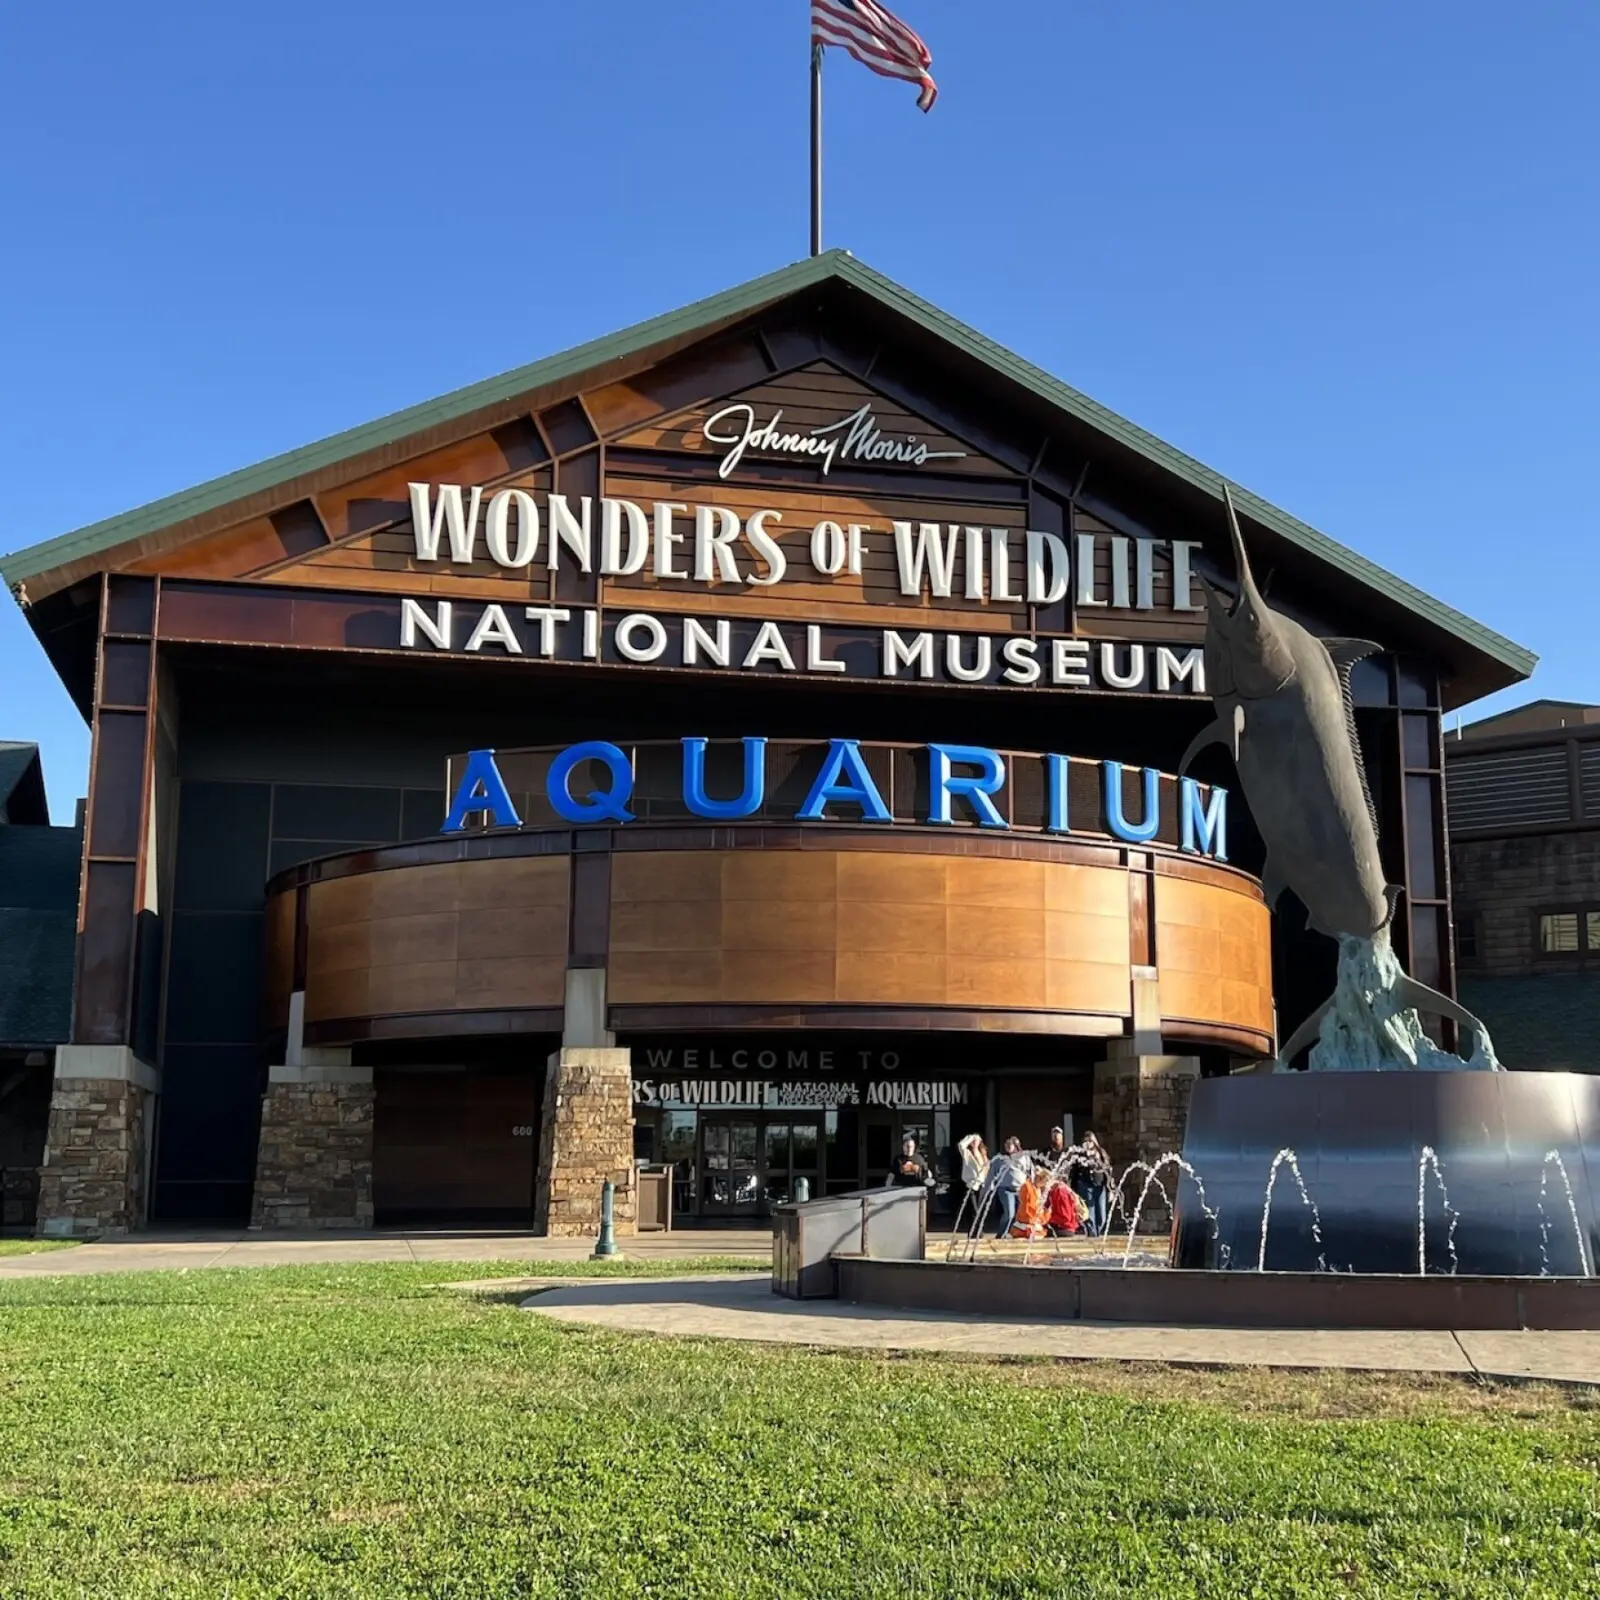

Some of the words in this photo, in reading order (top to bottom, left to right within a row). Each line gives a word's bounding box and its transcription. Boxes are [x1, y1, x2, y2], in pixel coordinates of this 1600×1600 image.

[703, 404, 840, 479] Johnny
[810, 402, 967, 465] Morris
[407, 482, 788, 587] WONDERS
[810, 520, 871, 575] OF
[892, 520, 1205, 612] WILDLIFE
[400, 598, 847, 674] NATIONAL
[883, 629, 1206, 693] MUSEUM
[441, 736, 1229, 862] AQUARIUM
[647, 1049, 834, 1070] WELCOME
[858, 1051, 901, 1071] TO
[659, 1082, 680, 1101] OF
[682, 1079, 774, 1104] WILDLIFE
[782, 1082, 860, 1095] NATIONAL
[866, 1080, 969, 1109] AQUARIUM
[512, 1125, 533, 1137] 600
